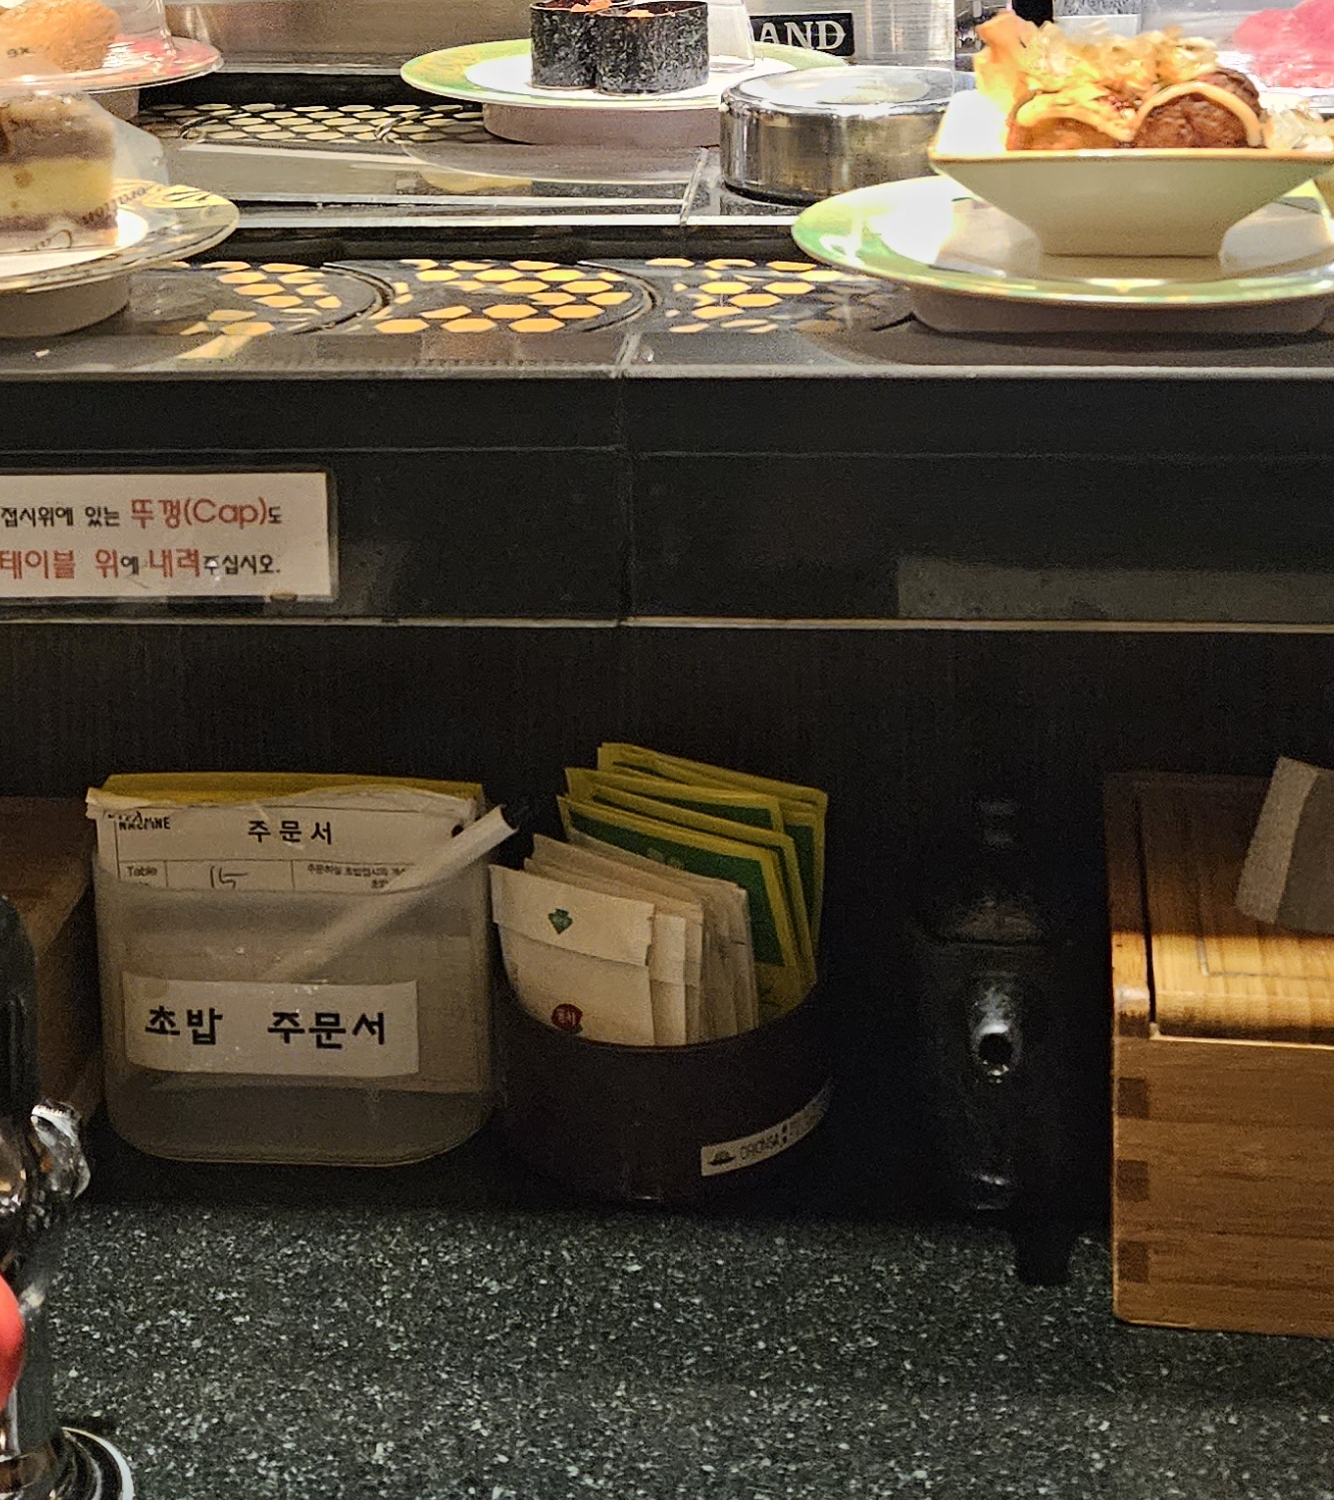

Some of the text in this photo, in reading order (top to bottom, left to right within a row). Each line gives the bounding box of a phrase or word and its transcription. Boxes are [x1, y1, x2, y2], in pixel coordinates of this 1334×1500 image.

[0, 506, 74, 528] 접시위에
[85, 505, 120, 527] 있는
[95, 549, 140, 578] 위에
[247, 819, 333, 845] 주문서
[144, 1005, 386, 1049] 초밥 주문서
